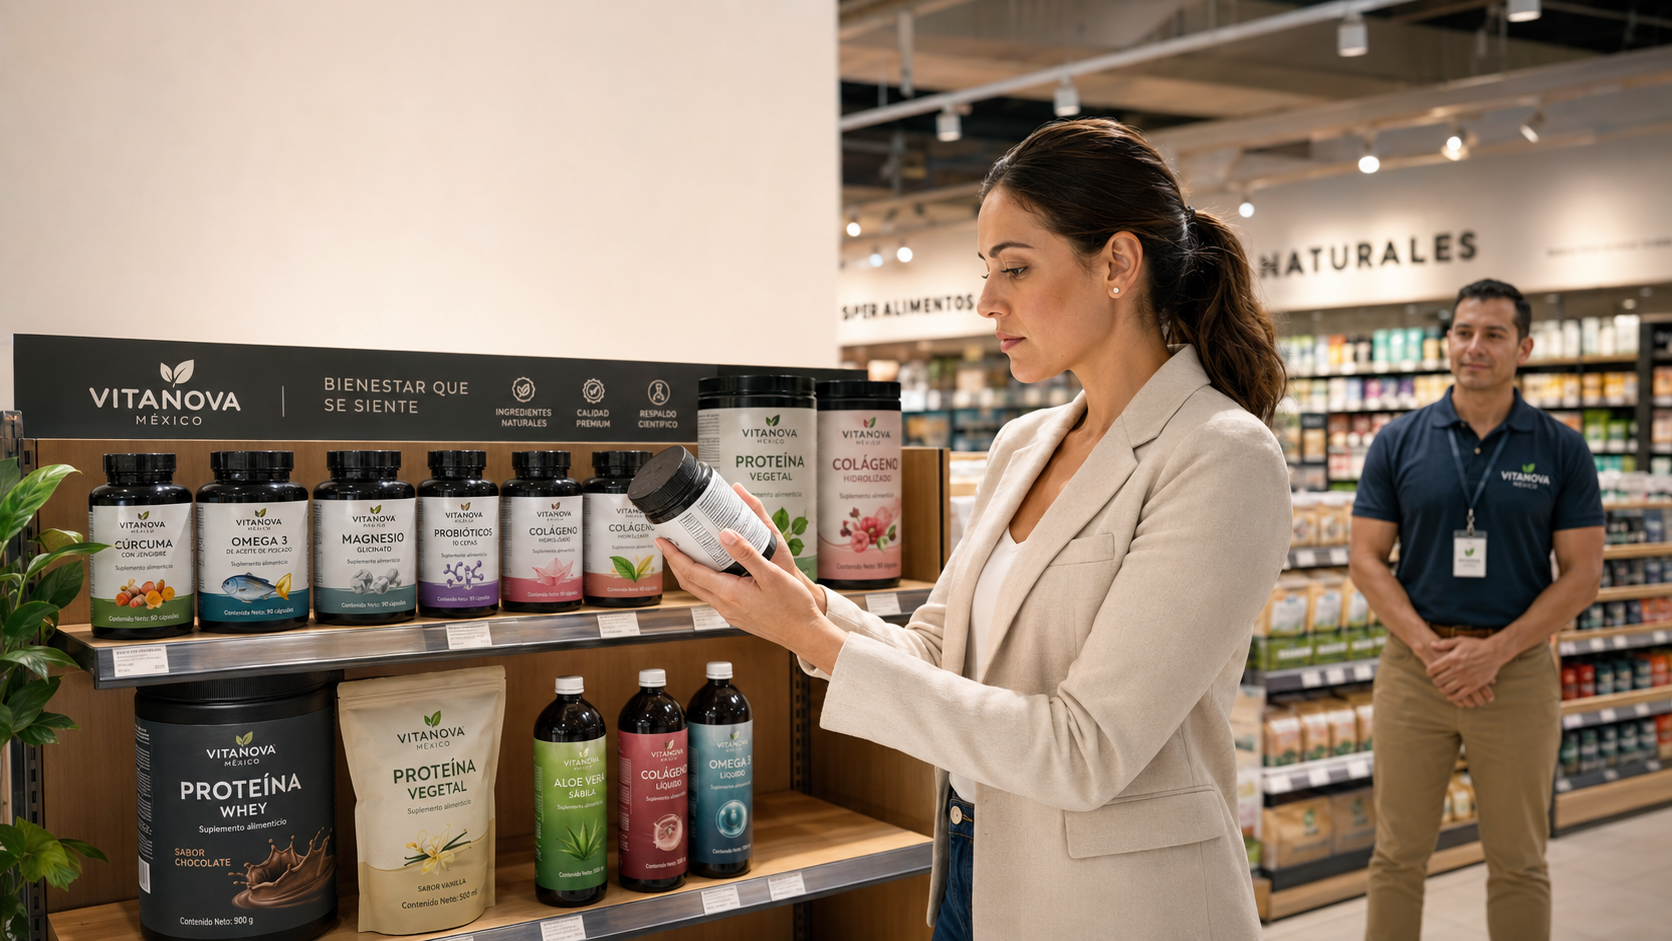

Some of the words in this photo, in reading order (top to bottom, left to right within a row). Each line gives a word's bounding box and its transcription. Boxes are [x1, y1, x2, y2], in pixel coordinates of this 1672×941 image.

[1259, 232, 1478, 279] NATURALES
[883, 294, 974, 316] ALIMENTOS
[324, 378, 426, 394] BIENESTAR
[433, 380, 468, 396] QUE
[89, 387, 241, 411] VITANOVA
[324, 398, 346, 412] SE
[355, 400, 418, 414] SIENTE
[496, 408, 552, 417] INGREDIENTES
[577, 409, 609, 417] CALIDAD
[640, 410, 676, 418] RESPALDO
[136, 412, 202, 426] MÉXICO
[502, 419, 547, 428] NATURALES
[576, 420, 610, 428] PREMIUM
[742, 428, 798, 438] VITANOVA
[842, 430, 891, 438] VITANOVA
[736, 452, 804, 468] PROTEÍNA
[833, 454, 898, 470] COLÁGENO
[750, 472, 792, 482] VEGETAL
[844, 474, 892, 483] HIDROLIZADO
[1501, 470, 1550, 485] VITANOVA
[236, 518, 282, 526] VITANOVA
[434, 527, 493, 538] PROBIÓTICOS
[529, 524, 577, 536] COLÁGENO
[114, 538, 173, 550] CÚRCUMA
[232, 536, 278, 546] OMEGA
[282, 536, 288, 545] 3
[342, 533, 404, 544] MAGNESIO
[397, 726, 465, 743] VITANOVA
[206, 744, 276, 759] VITANOVA
[564, 756, 600, 767] VITANOVA
[709, 758, 746, 770] OMEGA
[393, 757, 476, 784] PROTEÍNA
[641, 764, 687, 780] COLÁGENO
[180, 773, 302, 800] PROTEÍNA
[554, 778, 583, 787] ALOE
[408, 780, 467, 800] VEGETAL
[569, 788, 597, 798] SÁBILA
[220, 802, 268, 818] WHEY
[407, 804, 442, 816] Suplemento
[199, 824, 244, 834] Suplemento
[247, 818, 287, 830] alimenticio
[175, 848, 205, 857] SABOR
[175, 858, 231, 867] CHOCOLATE
[418, 883, 440, 892] SABOR
[401, 898, 439, 909] Contenido
[180, 917, 213, 926] Contenido
[214, 918, 233, 926] Neto:
[234, 916, 247, 924] 900
[249, 917, 253, 925] g
